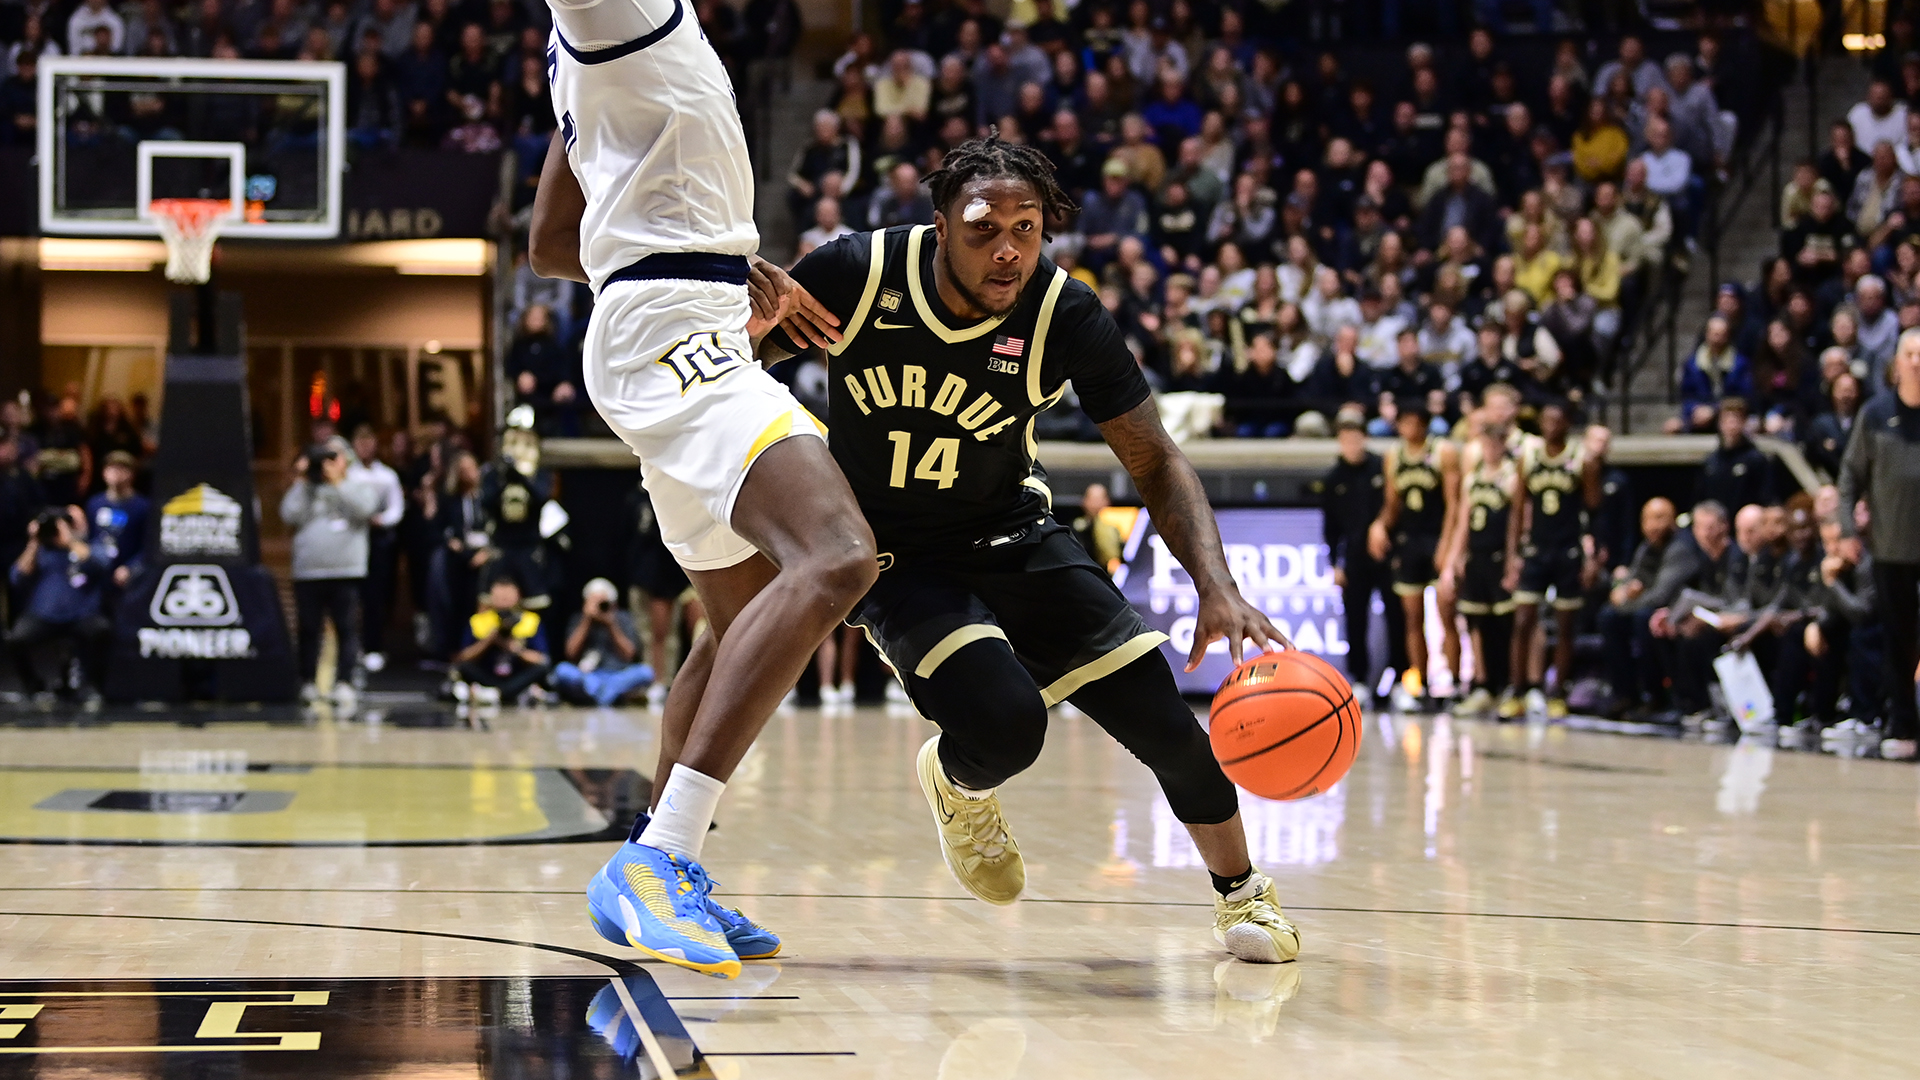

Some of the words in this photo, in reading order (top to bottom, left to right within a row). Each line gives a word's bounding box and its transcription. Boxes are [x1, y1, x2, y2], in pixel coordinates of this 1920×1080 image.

[880, 293, 900, 310] 50
[844, 364, 1017, 442] PURDUE
[887, 430, 961, 490] 14
